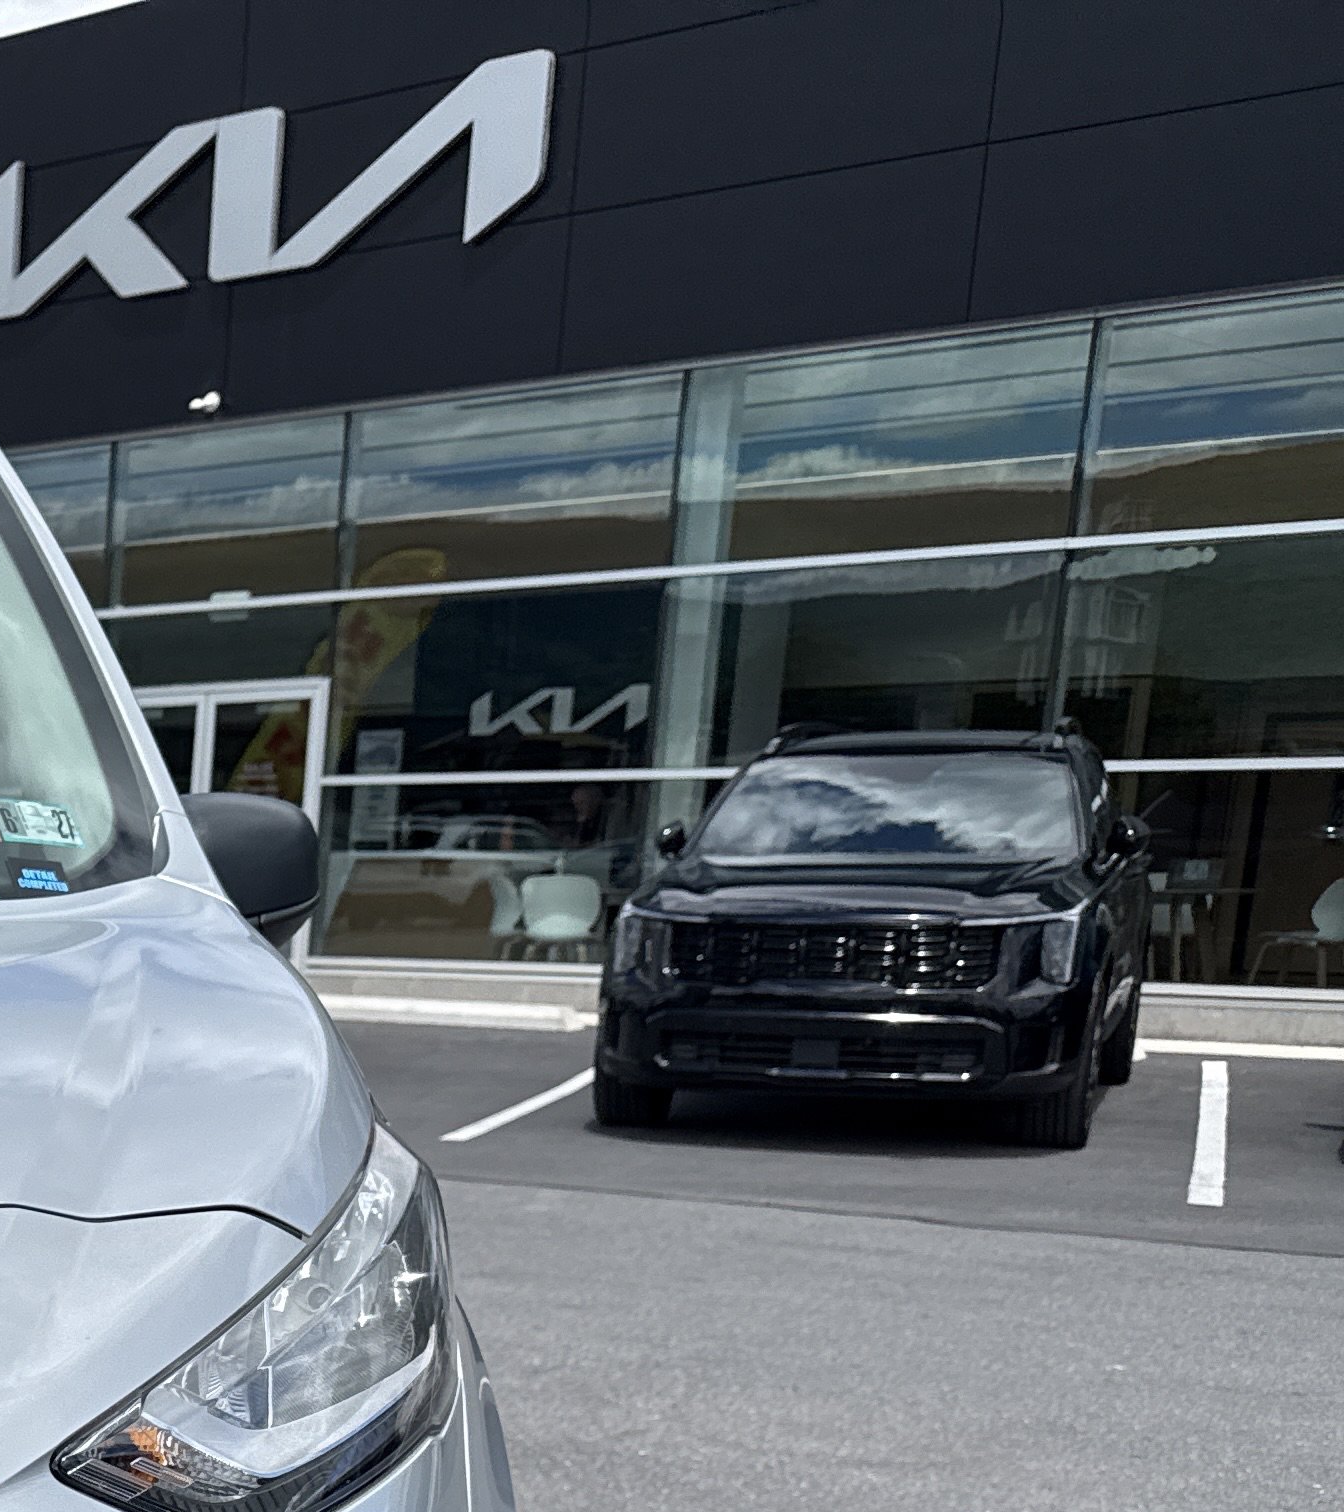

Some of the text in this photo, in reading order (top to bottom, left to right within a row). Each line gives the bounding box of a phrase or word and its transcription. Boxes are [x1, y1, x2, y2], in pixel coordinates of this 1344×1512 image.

[468, 683, 650, 737] KIA
[0, 807, 75, 839] 6 27
[18, 878, 69, 892] COMPLETED
[21, 868, 58, 881] DETAIL
